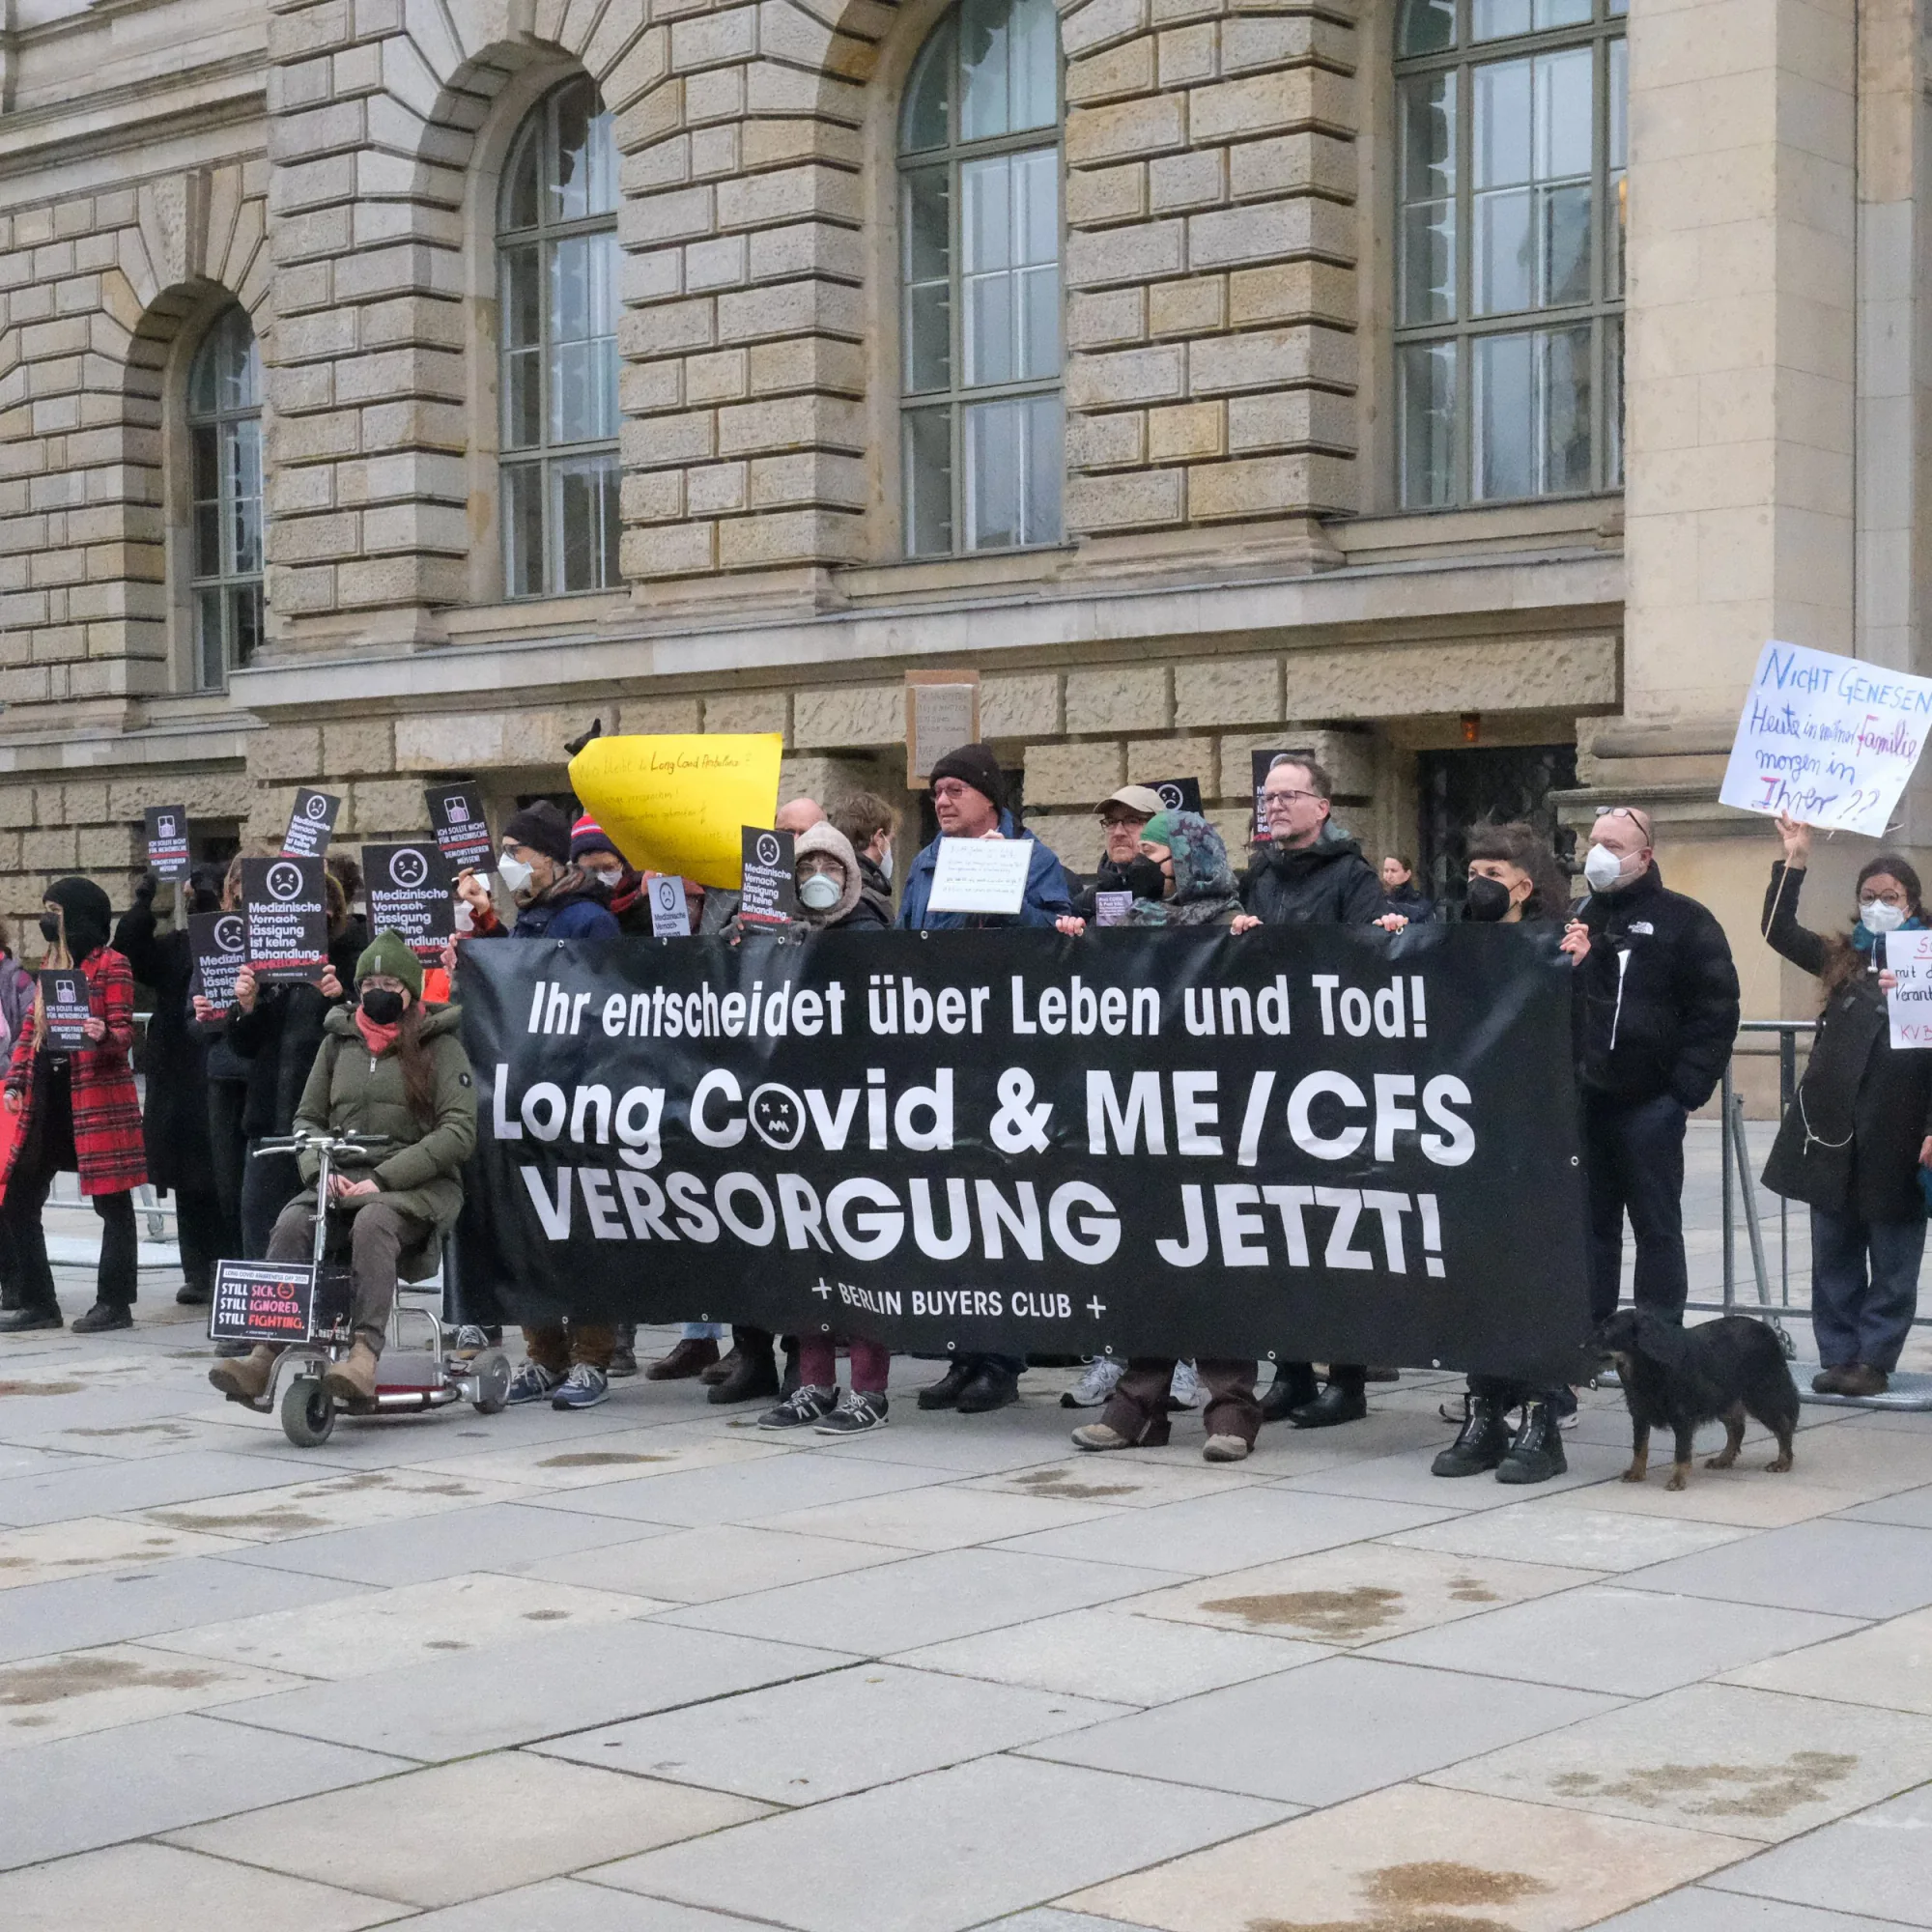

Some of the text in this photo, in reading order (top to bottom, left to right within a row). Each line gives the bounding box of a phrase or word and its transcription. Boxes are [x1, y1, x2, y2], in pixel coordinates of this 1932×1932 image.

[1760, 648, 1932, 714] NICHT GENESEN
[1749, 695, 1801, 739] Heute
[1804, 714, 1816, 739] in
[650, 752, 675, 775] Long
[1755, 749, 1855, 785] morgen in
[1753, 776, 1881, 822] Ihrer ??
[744, 863, 792, 880] Medizinische
[744, 872, 777, 887] Vernach-
[371, 889, 449, 901] Medizinische
[743, 883, 780, 899] lässigung
[372, 901, 427, 912] Vernach-
[742, 893, 773, 906] ist keine
[248, 901, 322, 914] Medizinische
[248, 914, 301, 924] Vernach-
[374, 912, 432, 925] lässigung
[249, 924, 305, 938] lässigung
[249, 937, 297, 948] ist keine
[199, 952, 245, 967] Medizini
[250, 949, 323, 962] Behandlung.
[201, 965, 241, 977] Vernac
[1894, 965, 1917, 979] mit
[203, 975, 237, 988] lässig
[205, 987, 218, 999] ist
[1895, 982, 1932, 1002] Verant
[527, 974, 1428, 1038] Ihr entscheidet über Leben und Tod!
[493, 1064, 1476, 1170] Long Covid & ME/CFS
[520, 1165, 1447, 1278] VERSORGUNG JETZT!
[221, 1283, 276, 1298] STILL SICK.
[220, 1297, 301, 1314] STILL IGNORED.
[838, 1282, 902, 1316] BERLIN
[911, 1291, 1004, 1317] BUYERS
[1011, 1291, 1072, 1319] CLUB
[218, 1312, 305, 1330] STILL FIGHTING.
